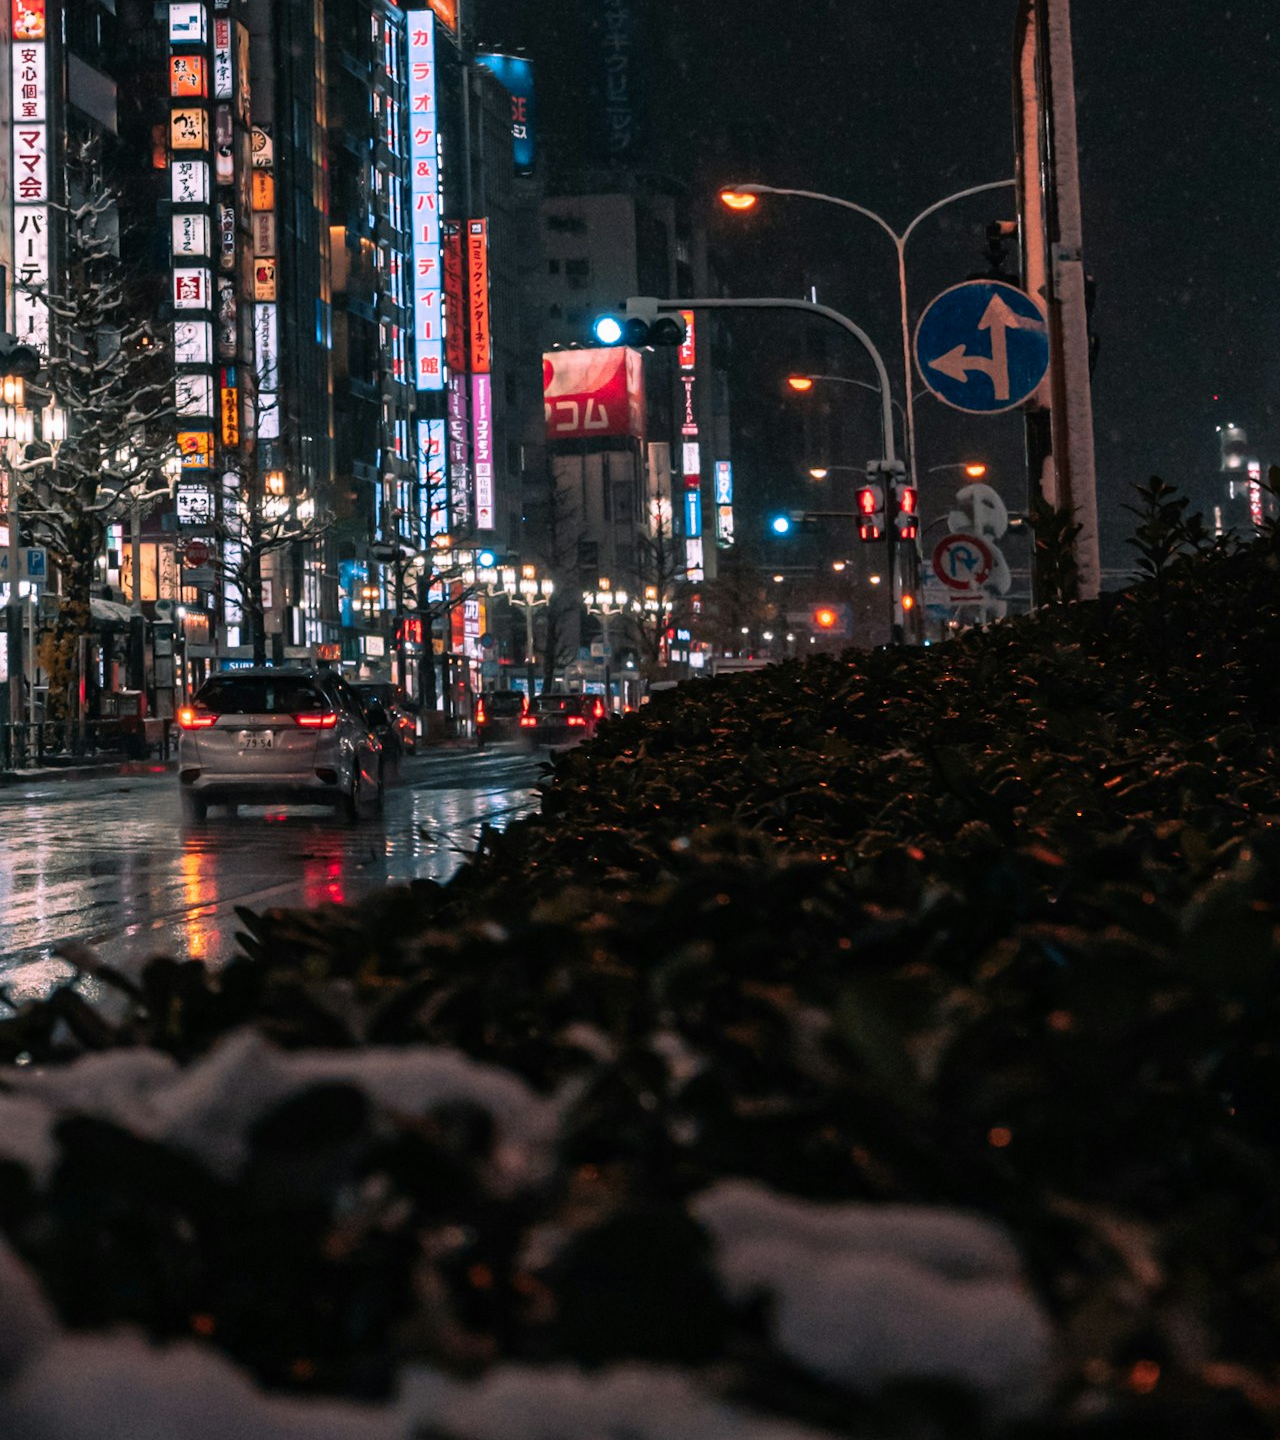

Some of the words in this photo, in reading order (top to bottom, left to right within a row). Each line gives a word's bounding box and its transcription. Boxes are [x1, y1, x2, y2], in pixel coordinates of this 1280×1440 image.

[20, 48, 38, 117] 安心個室
[19, 130, 42, 198] ママ会
[245, 737, 272, 749] 79-54
